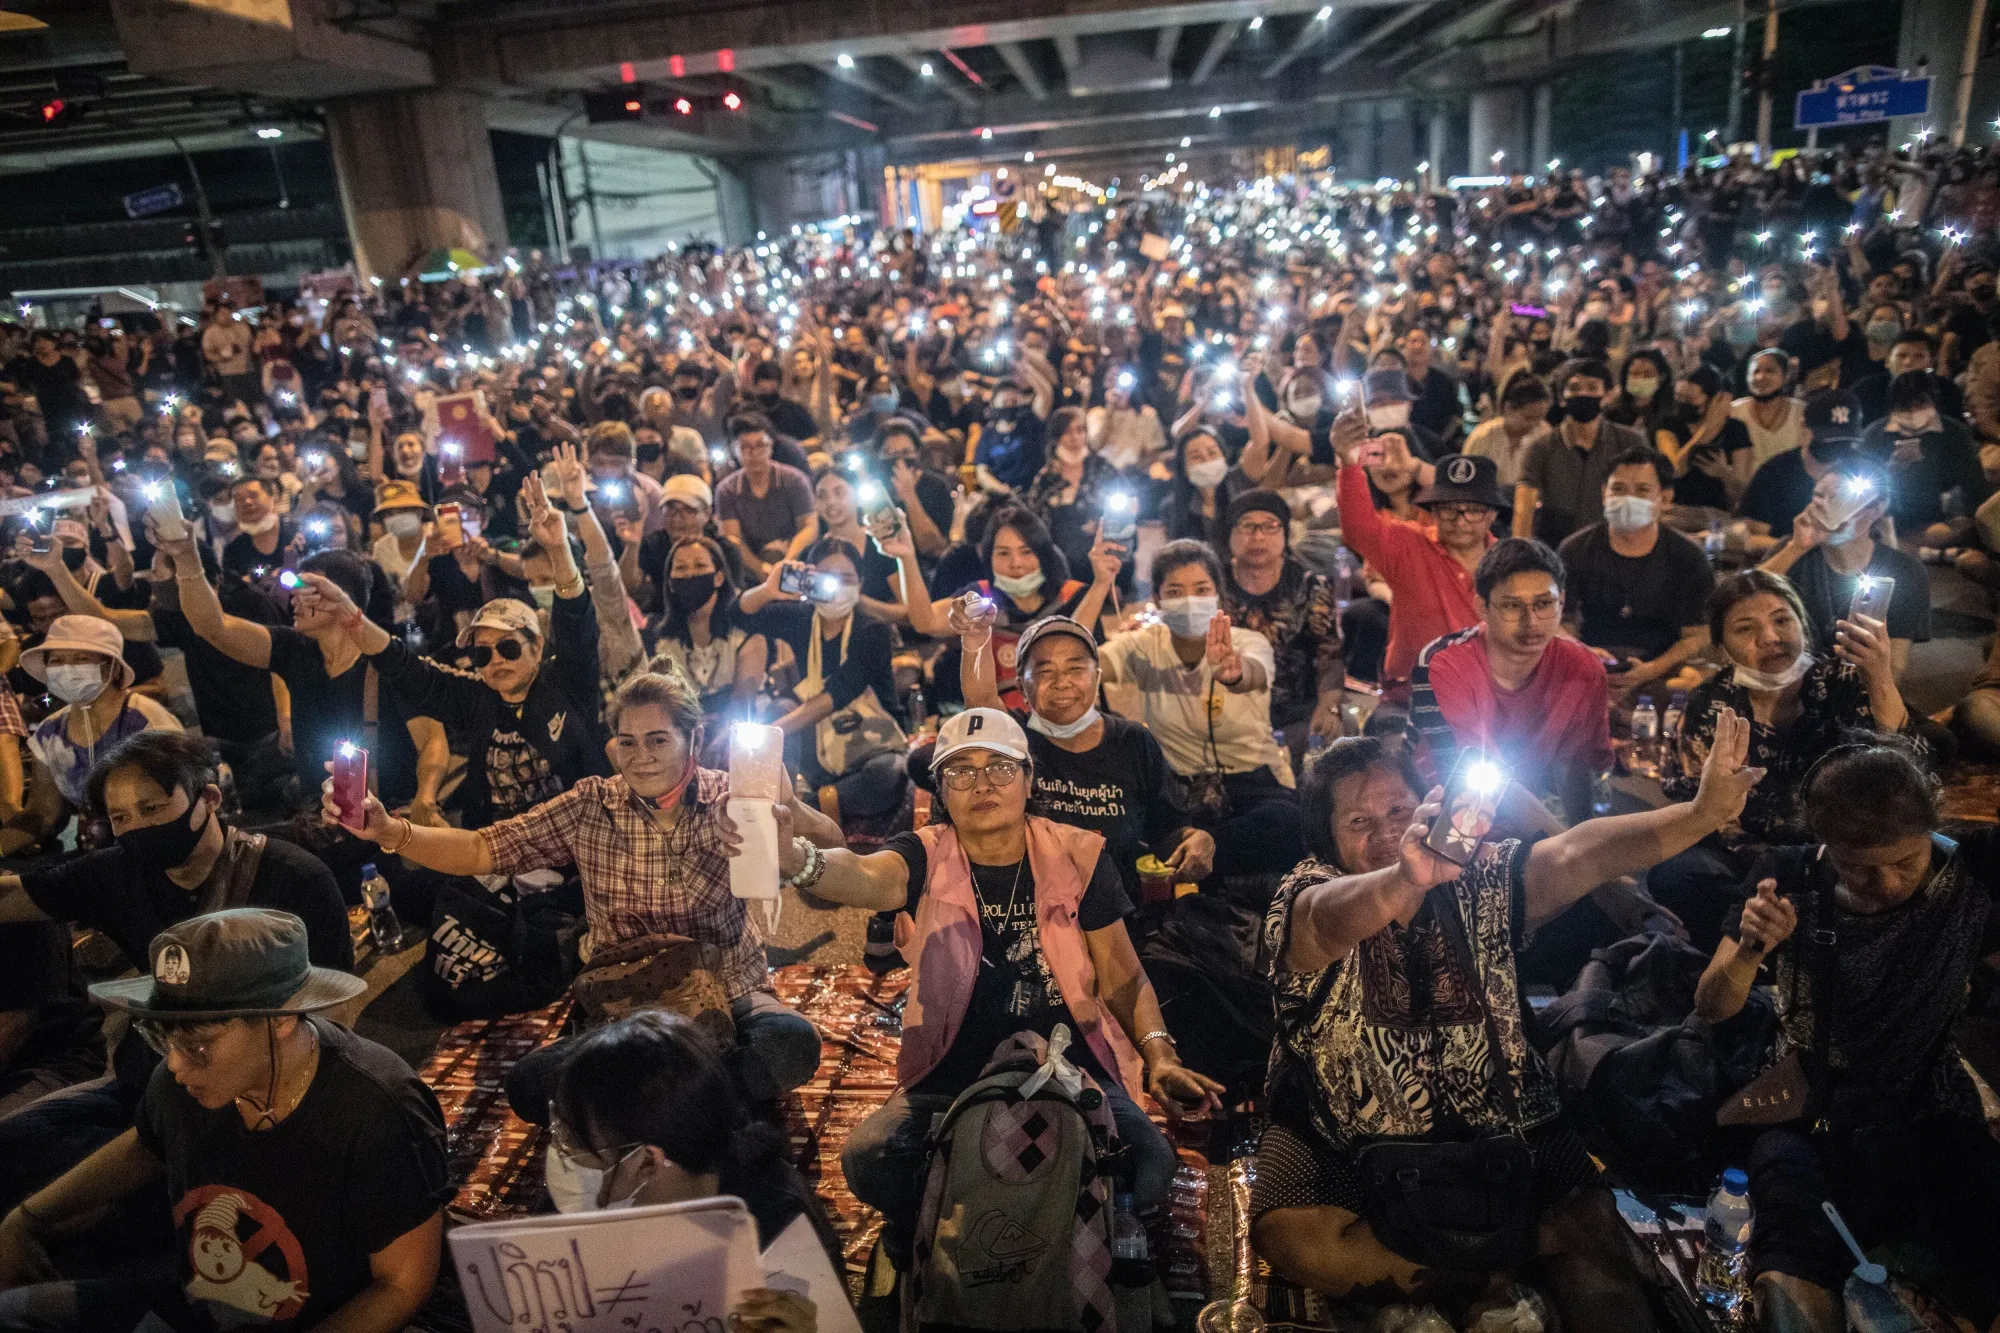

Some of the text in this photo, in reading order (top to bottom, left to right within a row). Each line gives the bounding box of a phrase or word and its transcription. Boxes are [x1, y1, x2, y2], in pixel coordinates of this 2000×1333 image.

[1037, 777, 1123, 802] ันเกิดในยุคผู้นำ
